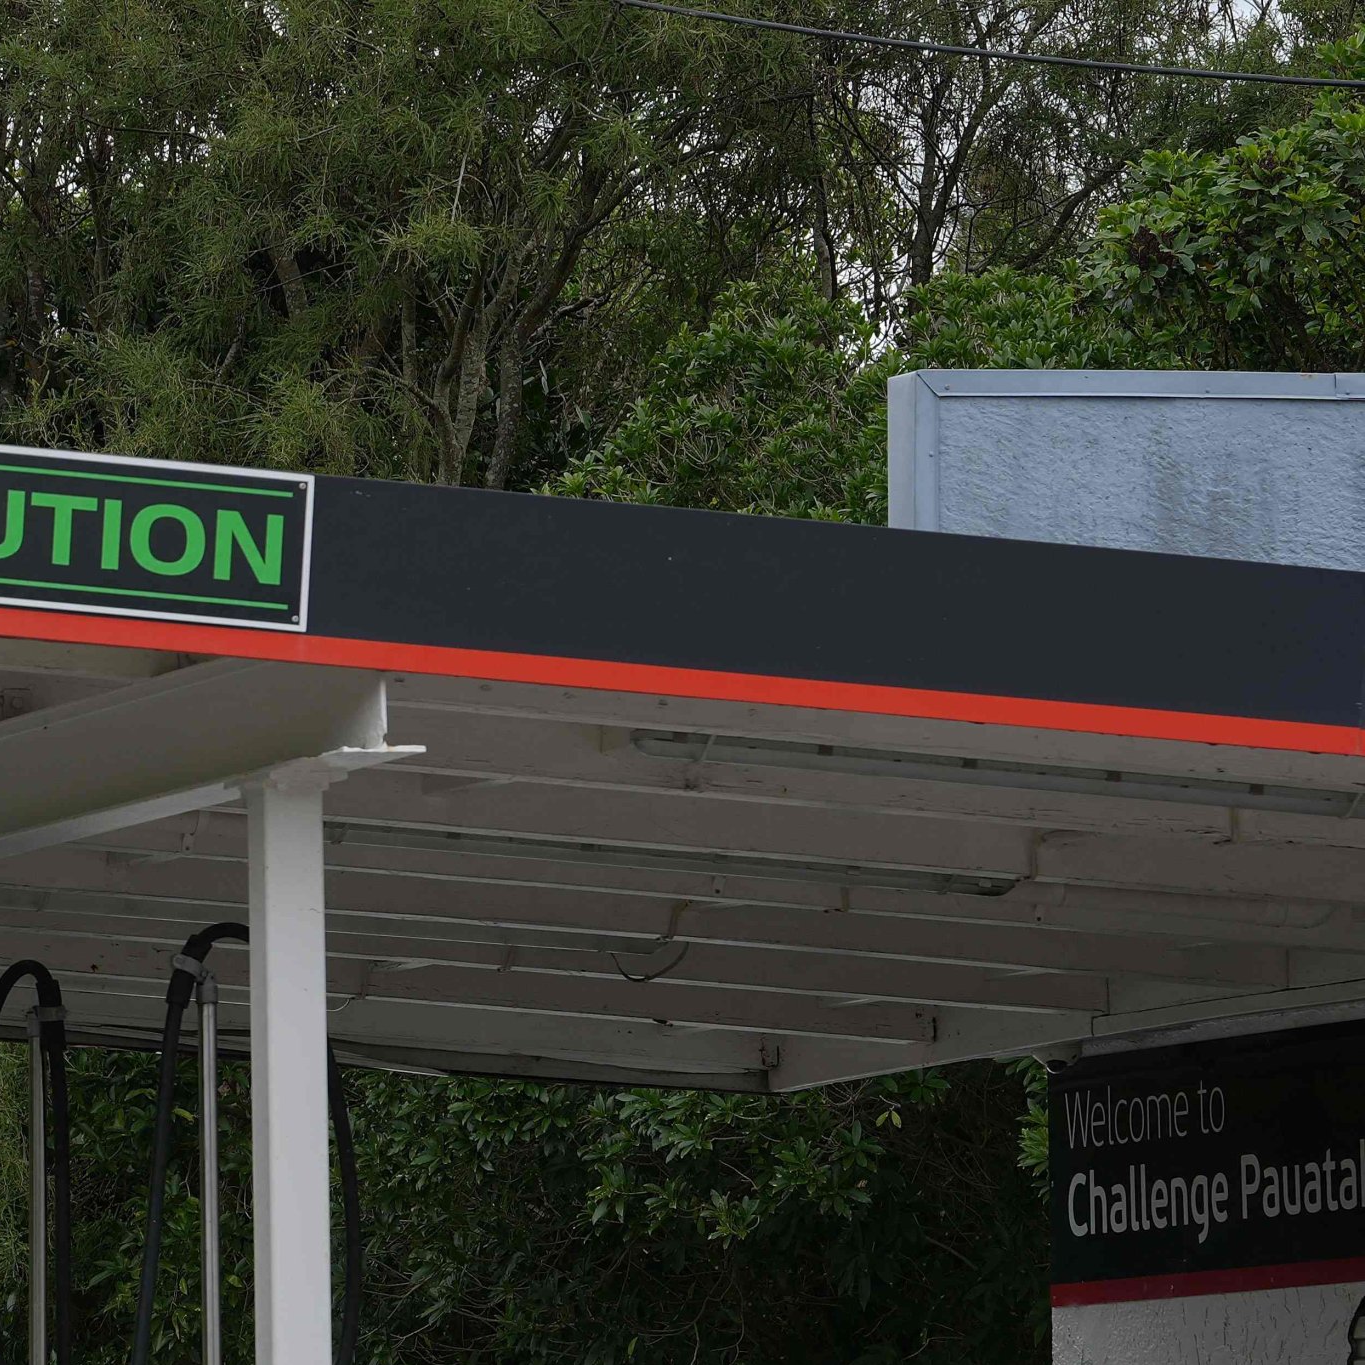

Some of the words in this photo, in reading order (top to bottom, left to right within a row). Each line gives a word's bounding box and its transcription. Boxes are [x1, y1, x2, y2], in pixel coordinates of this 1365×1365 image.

[1065, 1085, 1189, 1149] Welcome
[1197, 1079, 1225, 1134] to
[1069, 1163, 1229, 1244] Challenge
